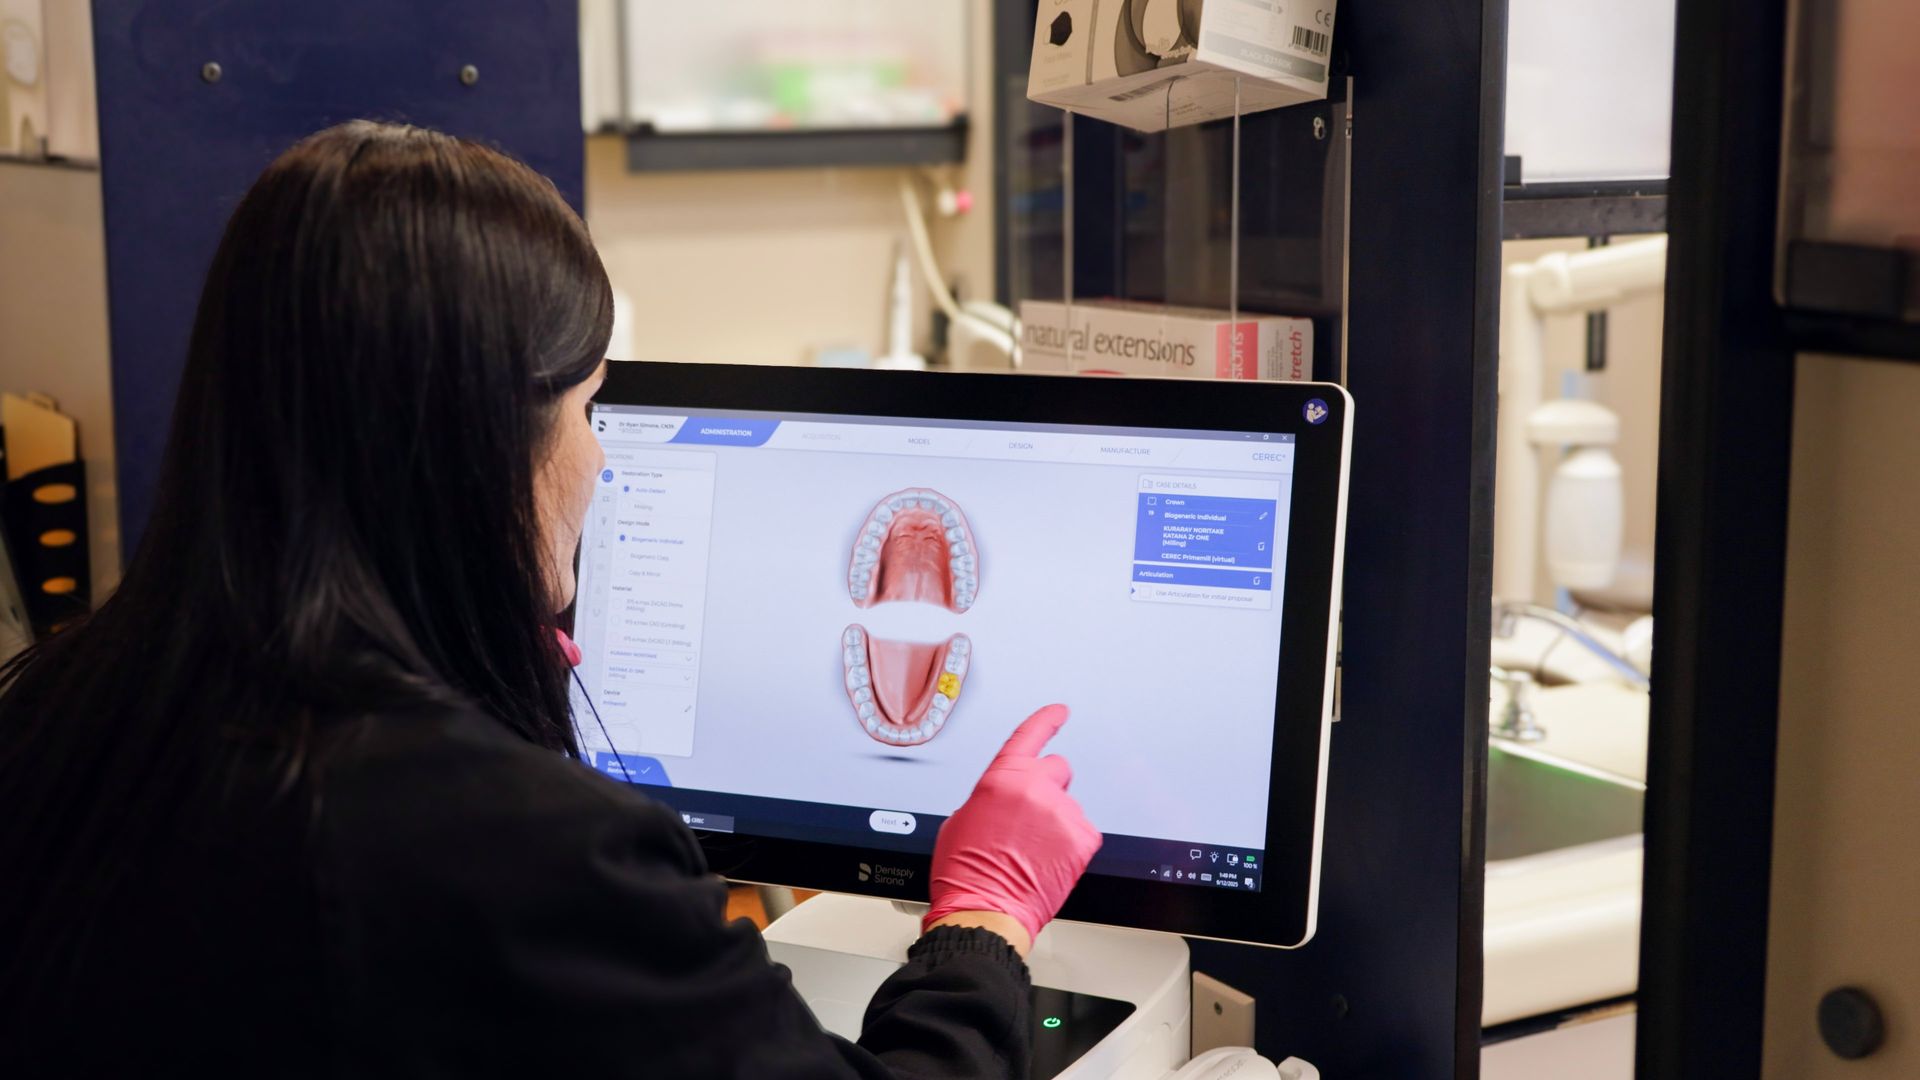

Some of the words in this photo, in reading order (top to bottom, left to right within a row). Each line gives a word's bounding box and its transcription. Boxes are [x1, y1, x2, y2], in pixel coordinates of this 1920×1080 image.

[1025, 322, 1090, 352] natural
[1093, 331, 1196, 367] extensions
[1288, 330, 1303, 380] tretch
[700, 427, 753, 438] ADMINISTRATION
[908, 437, 932, 446] MODEL
[1008, 441, 1034, 450] DESIGN
[1100, 446, 1152, 456] MANUFACTURE
[1173, 482, 1198, 491] DETAILS
[1164, 512, 1196, 521] Biogeneric
[1197, 514, 1227, 522] Individual
[1161, 552, 1182, 560] CEREC
[1139, 570, 1174, 579] Articulation
[881, 817, 897, 827] Next
[875, 864, 915, 880] Dentsply
[874, 874, 905, 887] Sirona
